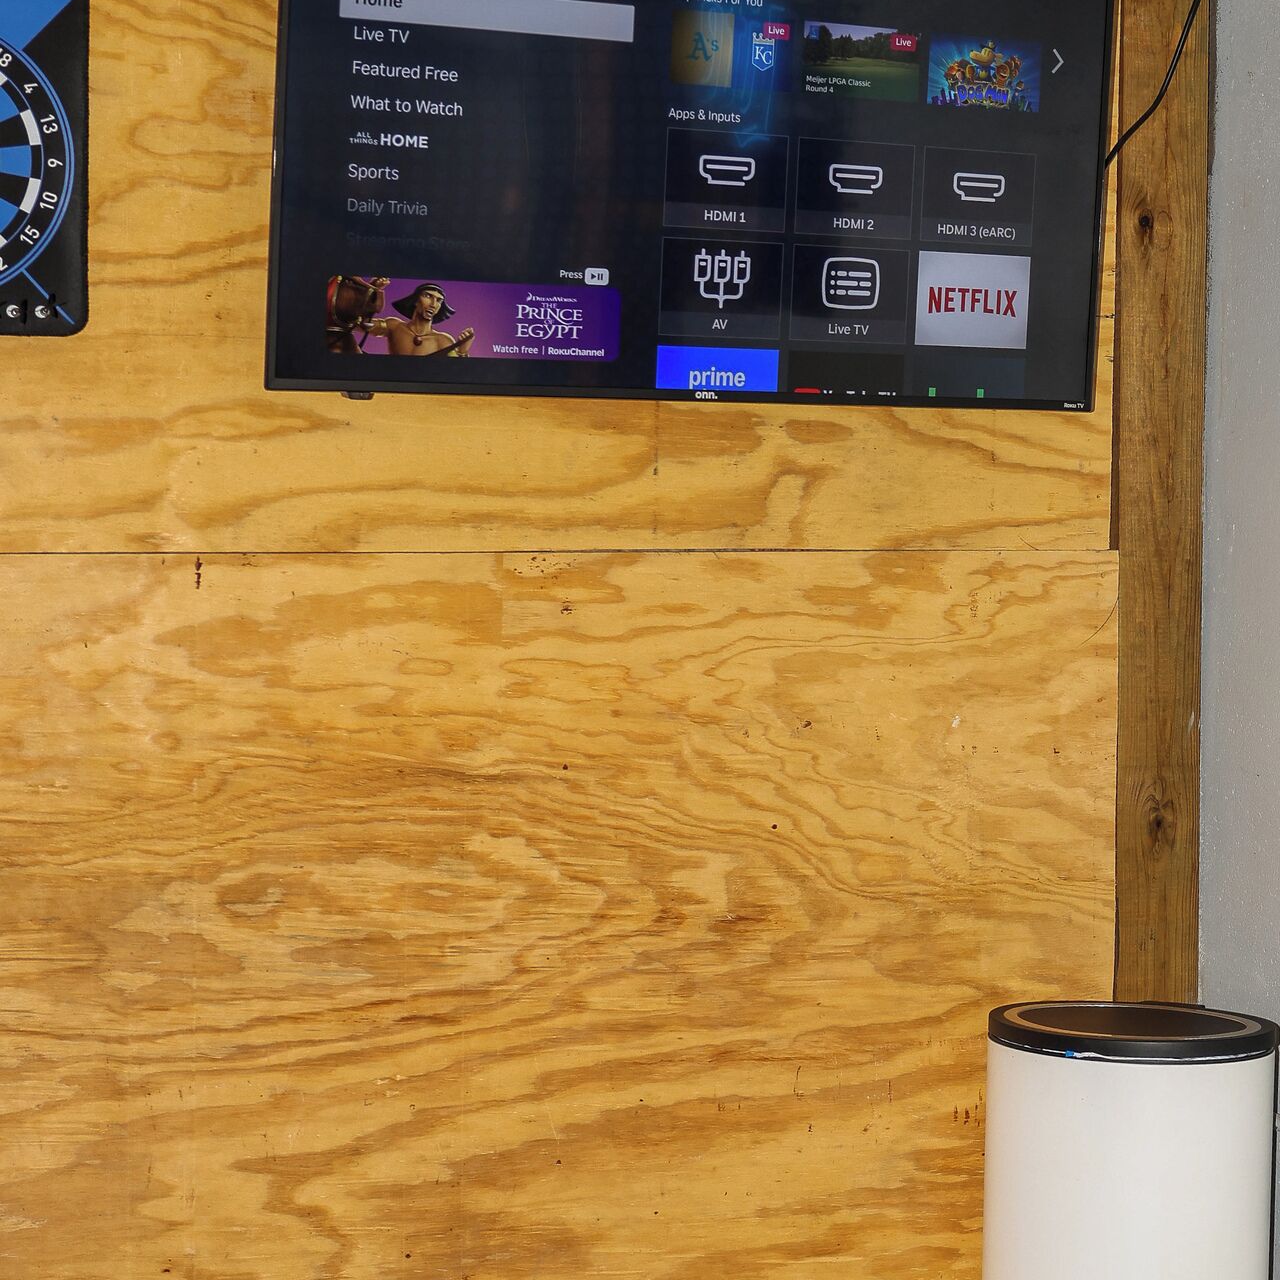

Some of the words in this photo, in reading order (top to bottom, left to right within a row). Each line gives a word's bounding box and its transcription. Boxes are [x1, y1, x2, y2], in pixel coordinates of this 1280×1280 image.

[354, 25, 385, 42] Live
[388, 28, 410, 44] TV
[768, 25, 785, 35] Live
[895, 37, 912, 48] Live
[755, 45, 773, 66] KC
[352, 60, 421, 80] Featured
[425, 66, 459, 82] Free
[23, 82, 39, 94] 4
[805, 84, 828, 94] Round
[829, 86, 835, 94] 4
[806, 75, 827, 85] Meijer
[828, 76, 847, 86] LPGA
[848, 78, 872, 88] Classic
[350, 94, 391, 112] What
[395, 98, 412, 113] to
[416, 99, 463, 117] Watch
[40, 113, 59, 134] 13
[668, 107, 697, 122] Apps
[698, 109, 707, 121] &
[708, 109, 742, 124] Inputs
[349, 137, 379, 146] THINGS
[380, 132, 429, 149] HOME
[356, 131, 371, 139] ALL
[348, 163, 400, 181] Sports
[39, 191, 58, 210] 10
[347, 198, 384, 217] Daily
[388, 200, 429, 216] Trivia
[704, 209, 736, 223] HDMI
[738, 211, 746, 223] 1
[833, 217, 863, 231] HDMI
[865, 219, 874, 231] 2
[20, 224, 40, 245] 15
[937, 224, 967, 238] HDMI
[969, 225, 977, 238] 3
[978, 225, 1016, 241] (eARC)
[559, 269, 584, 280] Press
[928, 286, 1017, 318] NETFLIX
[516, 304, 583, 325] PRINCE
[711, 318, 728, 331] AV
[828, 323, 849, 336] Live
[851, 325, 869, 337] TV
[492, 344, 519, 354] Watch
[521, 345, 539, 354] free
[688, 366, 746, 389] prime
[695, 391, 718, 400] onn.
